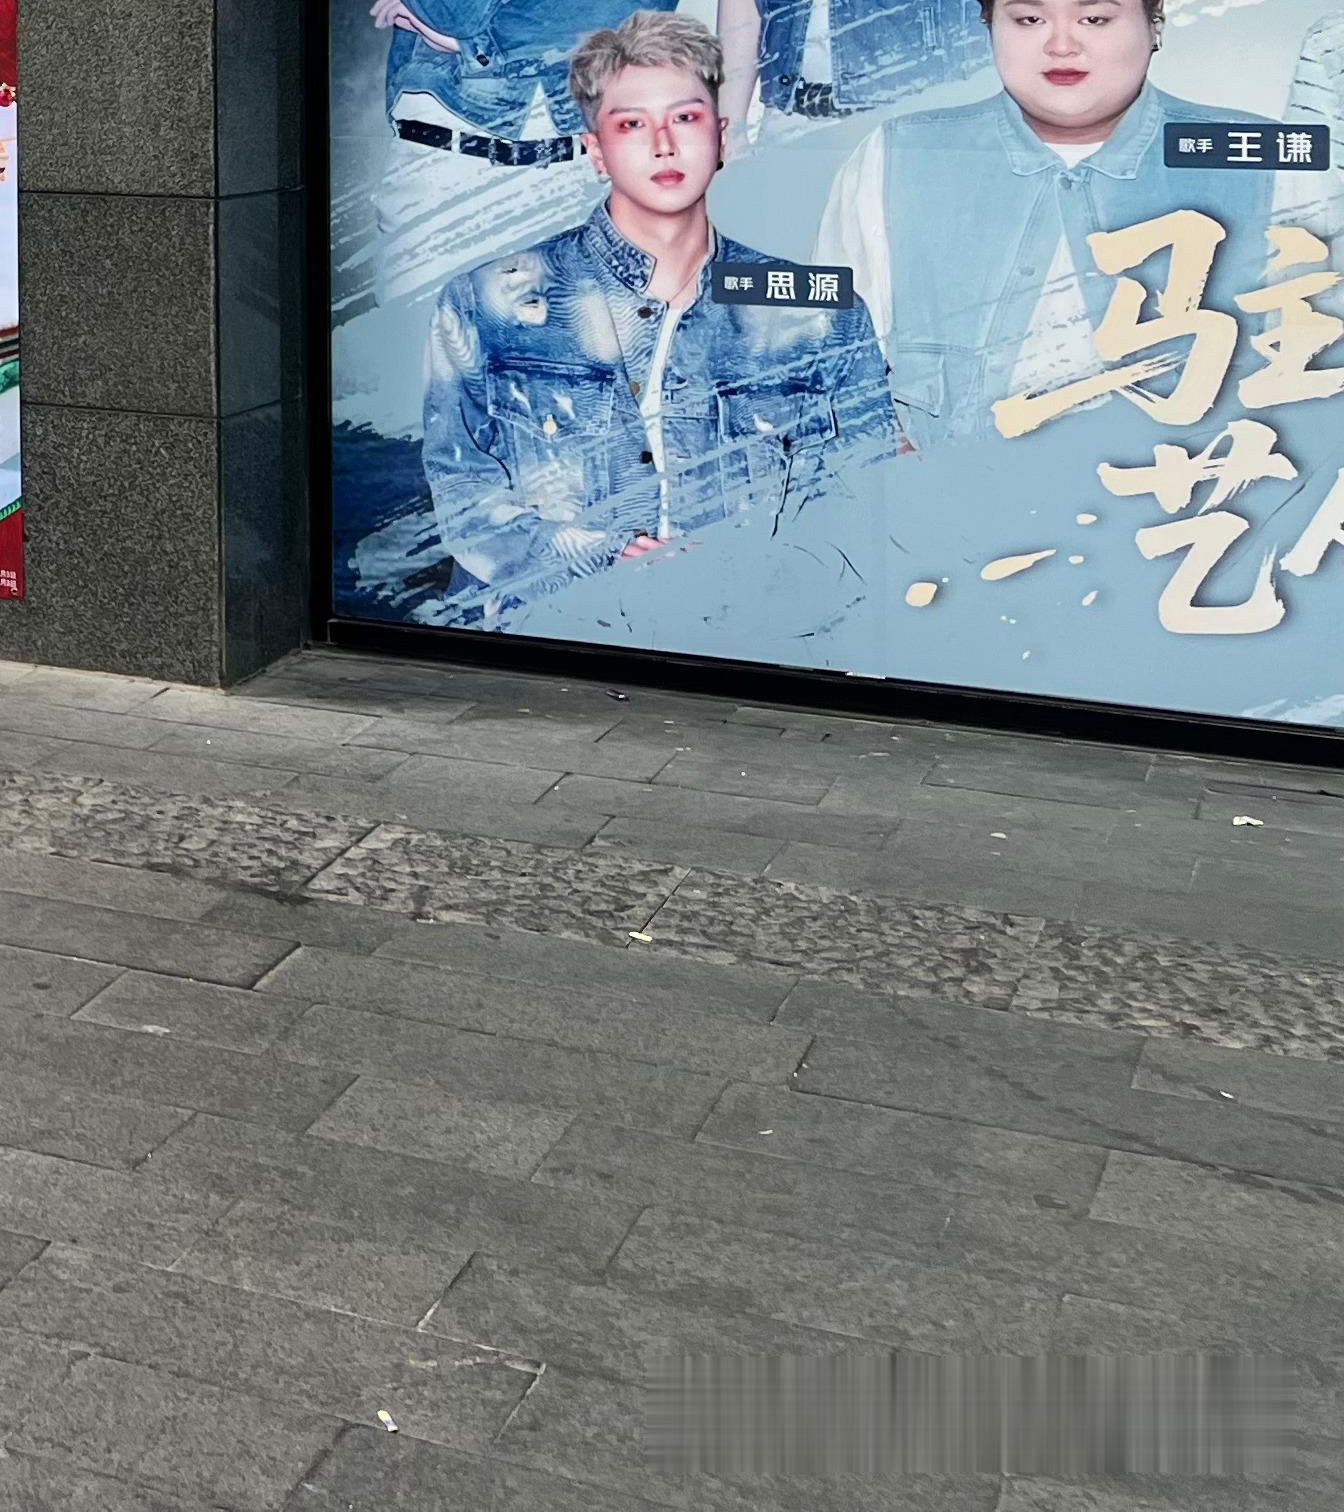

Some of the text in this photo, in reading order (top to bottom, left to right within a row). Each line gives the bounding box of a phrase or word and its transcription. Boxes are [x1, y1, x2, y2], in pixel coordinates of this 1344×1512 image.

[1178, 131, 1313, 163] 歌手 王谦
[724, 270, 840, 302] 歌手 思源
